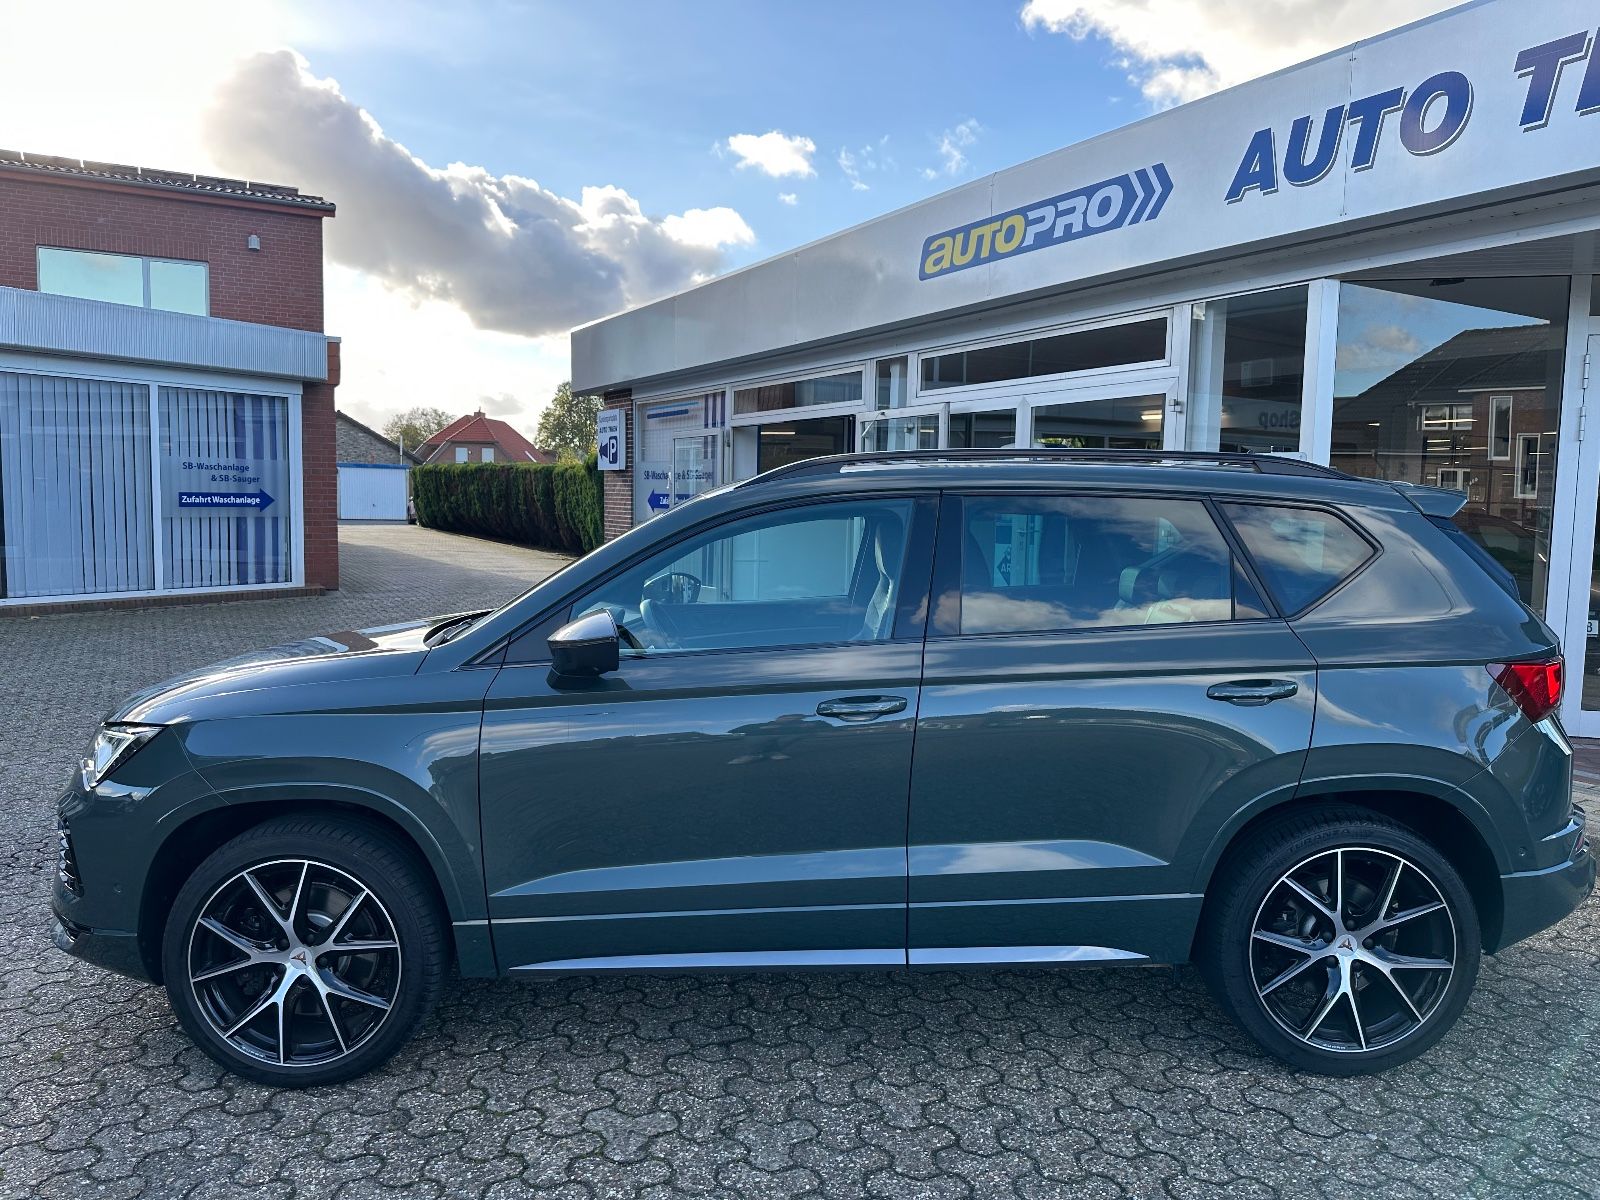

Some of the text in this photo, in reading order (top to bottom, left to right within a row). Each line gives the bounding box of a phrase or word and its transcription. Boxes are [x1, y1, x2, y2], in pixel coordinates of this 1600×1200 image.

[1224, 71, 1474, 205] AUTO
[182, 462, 250, 473] SB-Waschanlage
[211, 474, 260, 484] & SB-Sauger
[181, 495, 260, 505] Zufahrt Waschanlage
